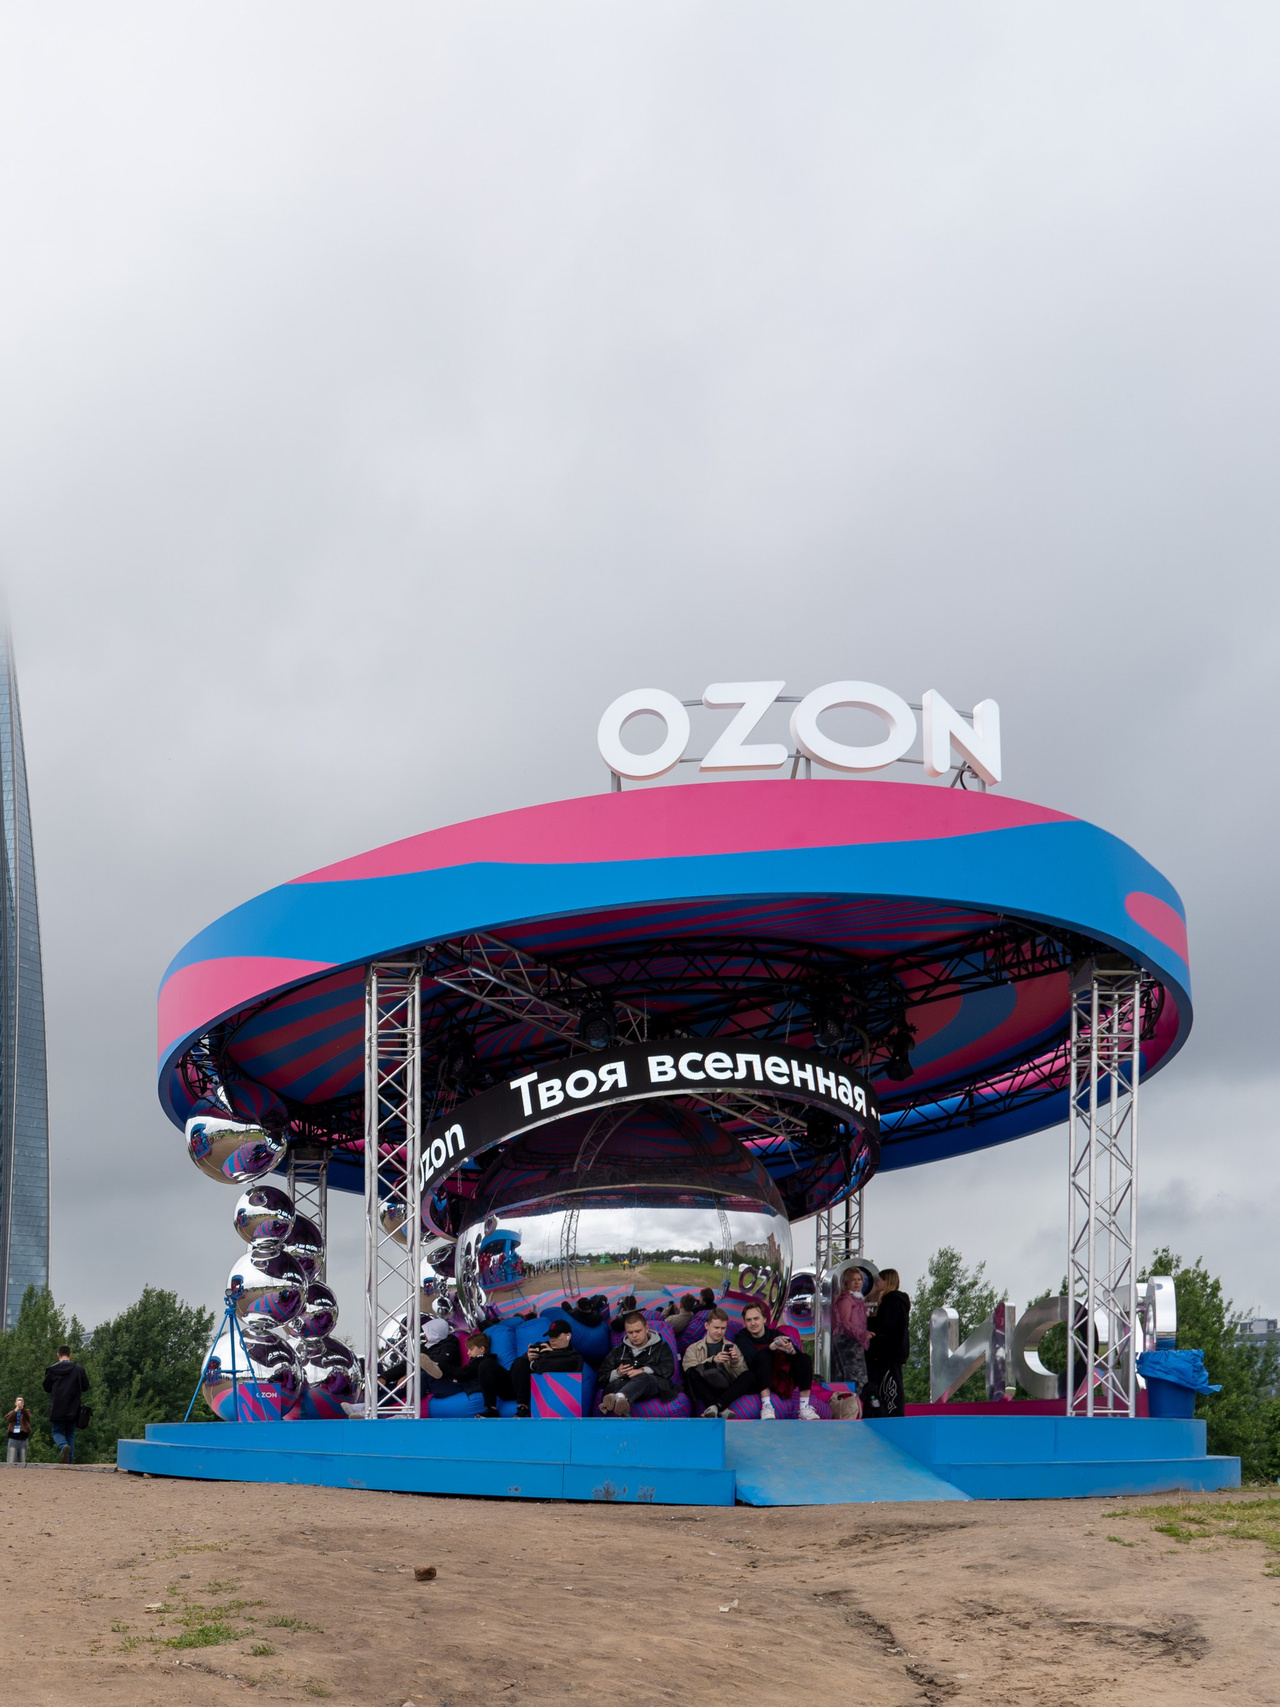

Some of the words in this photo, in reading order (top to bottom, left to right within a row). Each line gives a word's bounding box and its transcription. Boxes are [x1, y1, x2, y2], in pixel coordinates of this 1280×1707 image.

[597, 680, 1002, 786] OZON
[510, 1060, 628, 1116] Твоя
[647, 1051, 867, 1118] вселенная
